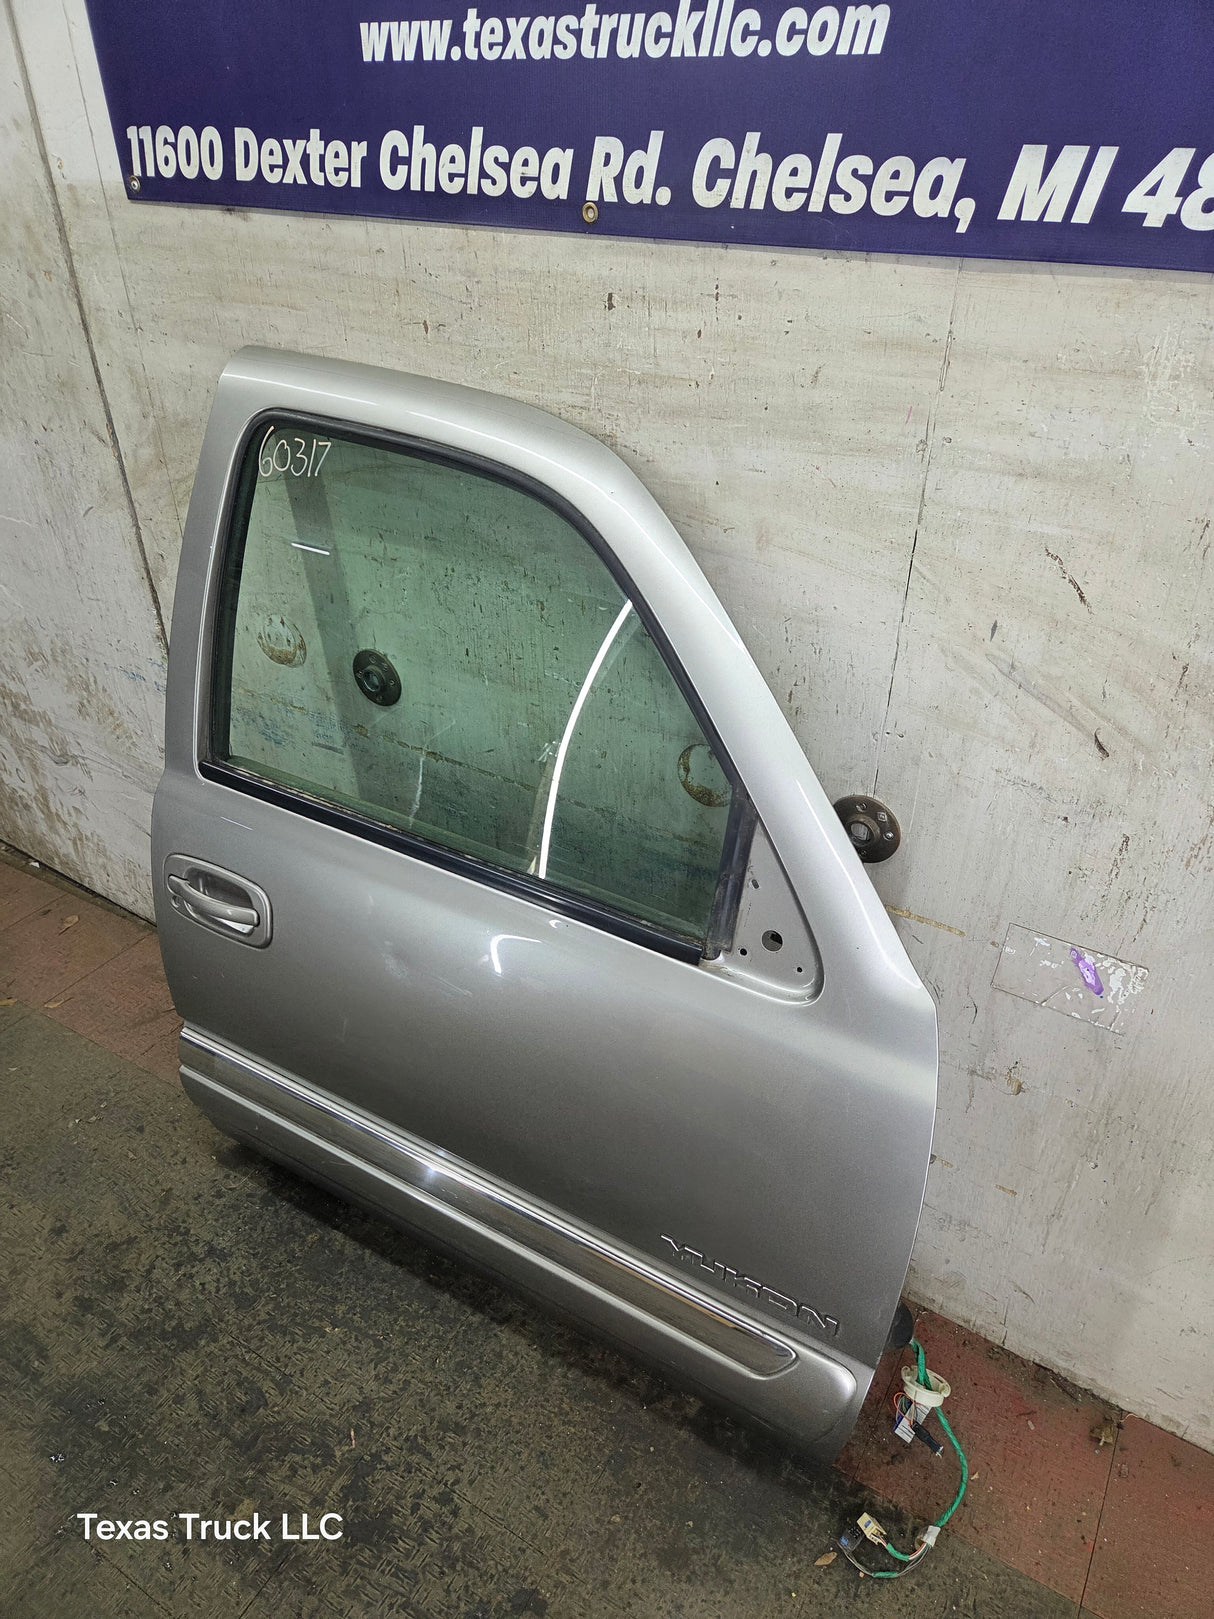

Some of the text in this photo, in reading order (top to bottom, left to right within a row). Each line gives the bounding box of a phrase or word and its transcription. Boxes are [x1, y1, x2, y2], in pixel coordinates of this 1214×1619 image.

[360, 0, 890, 62] www.texastruckllc.com
[126, 125, 224, 181] 11600
[234, 127, 368, 188] Dexter
[379, 125, 574, 200] Chelsea
[585, 129, 671, 205] Rd.
[692, 131, 976, 233] Chelsea,
[997, 144, 1120, 224] MI
[258, 425, 332, 477] 60317
[660, 1233, 839, 1336] YUKON
